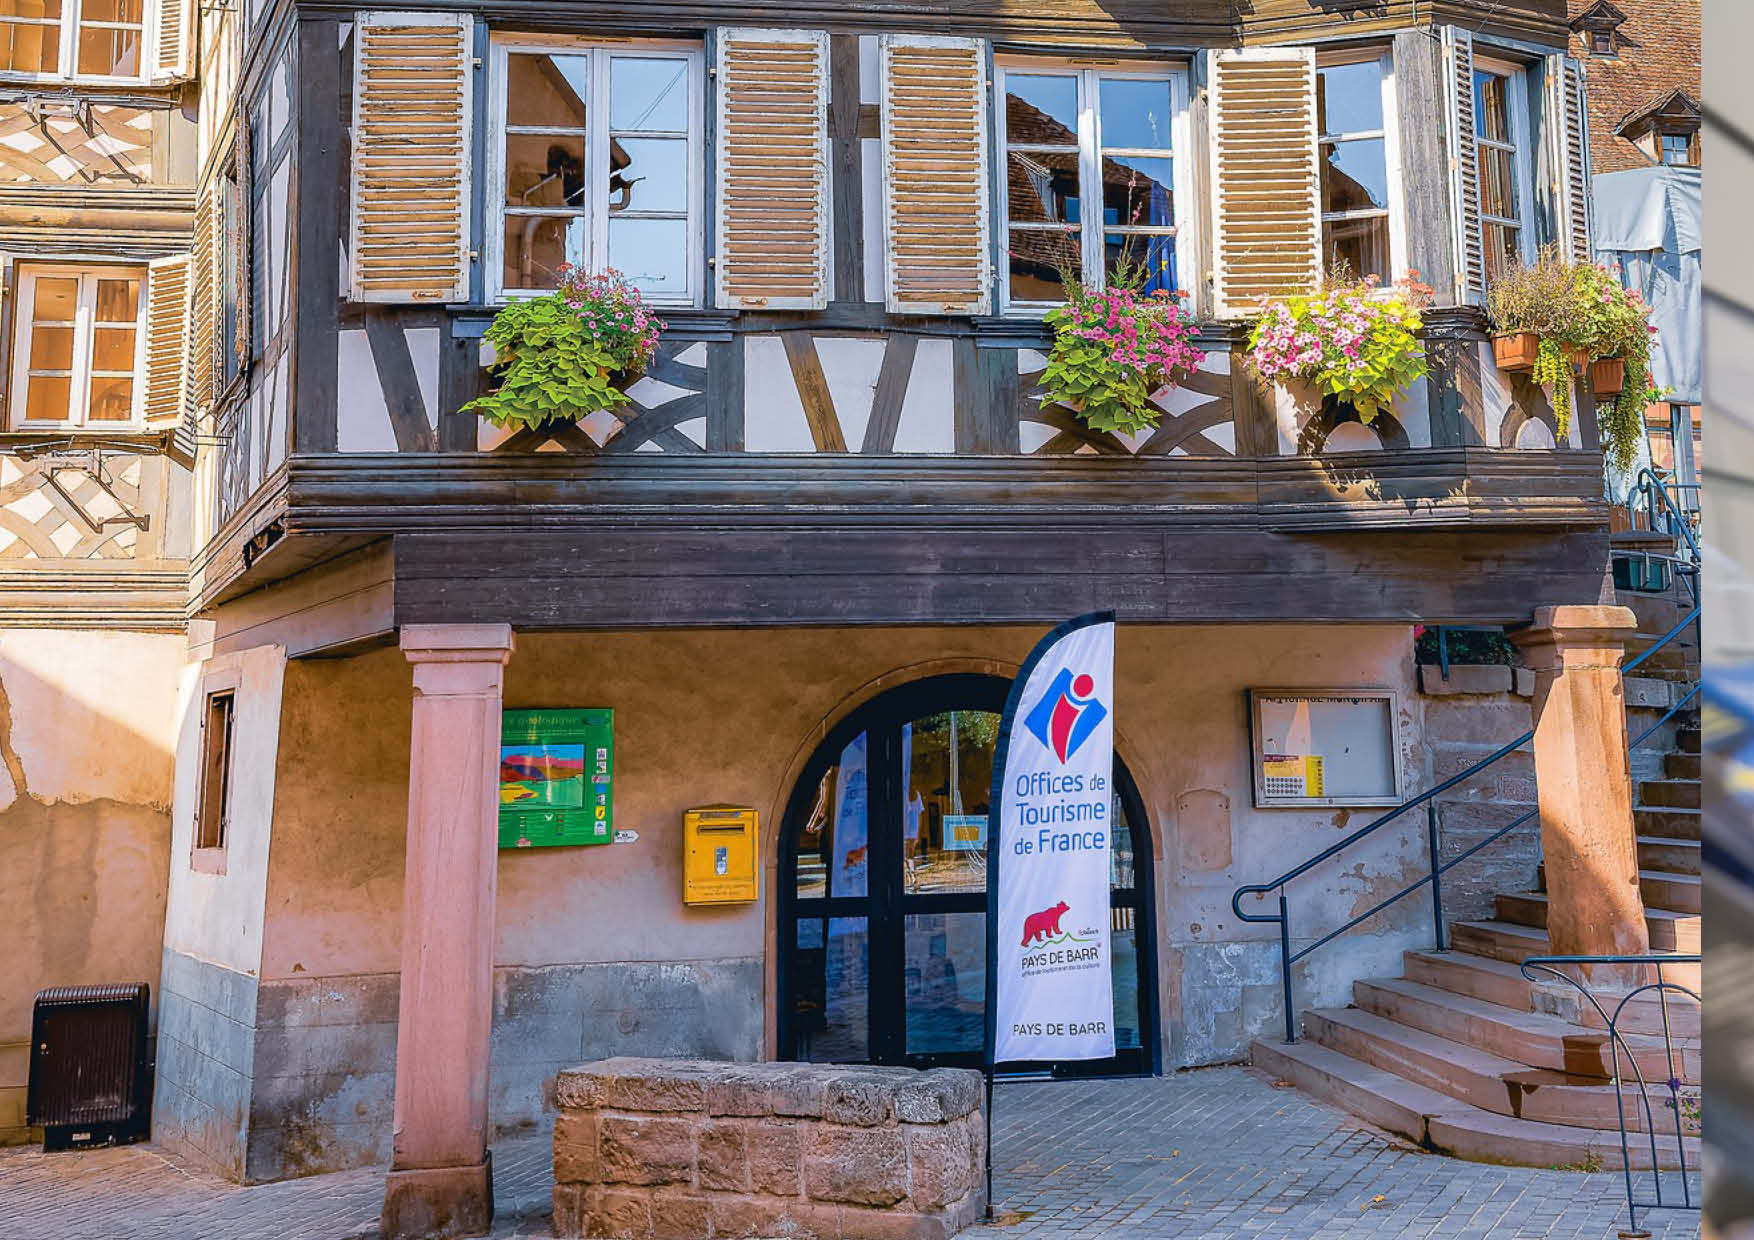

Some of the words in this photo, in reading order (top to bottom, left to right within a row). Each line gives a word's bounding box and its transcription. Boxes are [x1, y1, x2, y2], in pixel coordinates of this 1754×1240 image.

[1016, 771, 1084, 797] Offices
[1089, 773, 1105, 791] de
[1015, 798, 1105, 826] Tourisme
[1014, 837, 1034, 855] de
[1038, 829, 1105, 853] France
[1021, 953, 1047, 970] PAYS
[1049, 950, 1065, 965] DE
[1066, 946, 1099, 963] BARR
[1013, 1023, 1042, 1036] PAYS
[1046, 1022, 1065, 1036] DE
[1069, 1021, 1107, 1036] BARR
